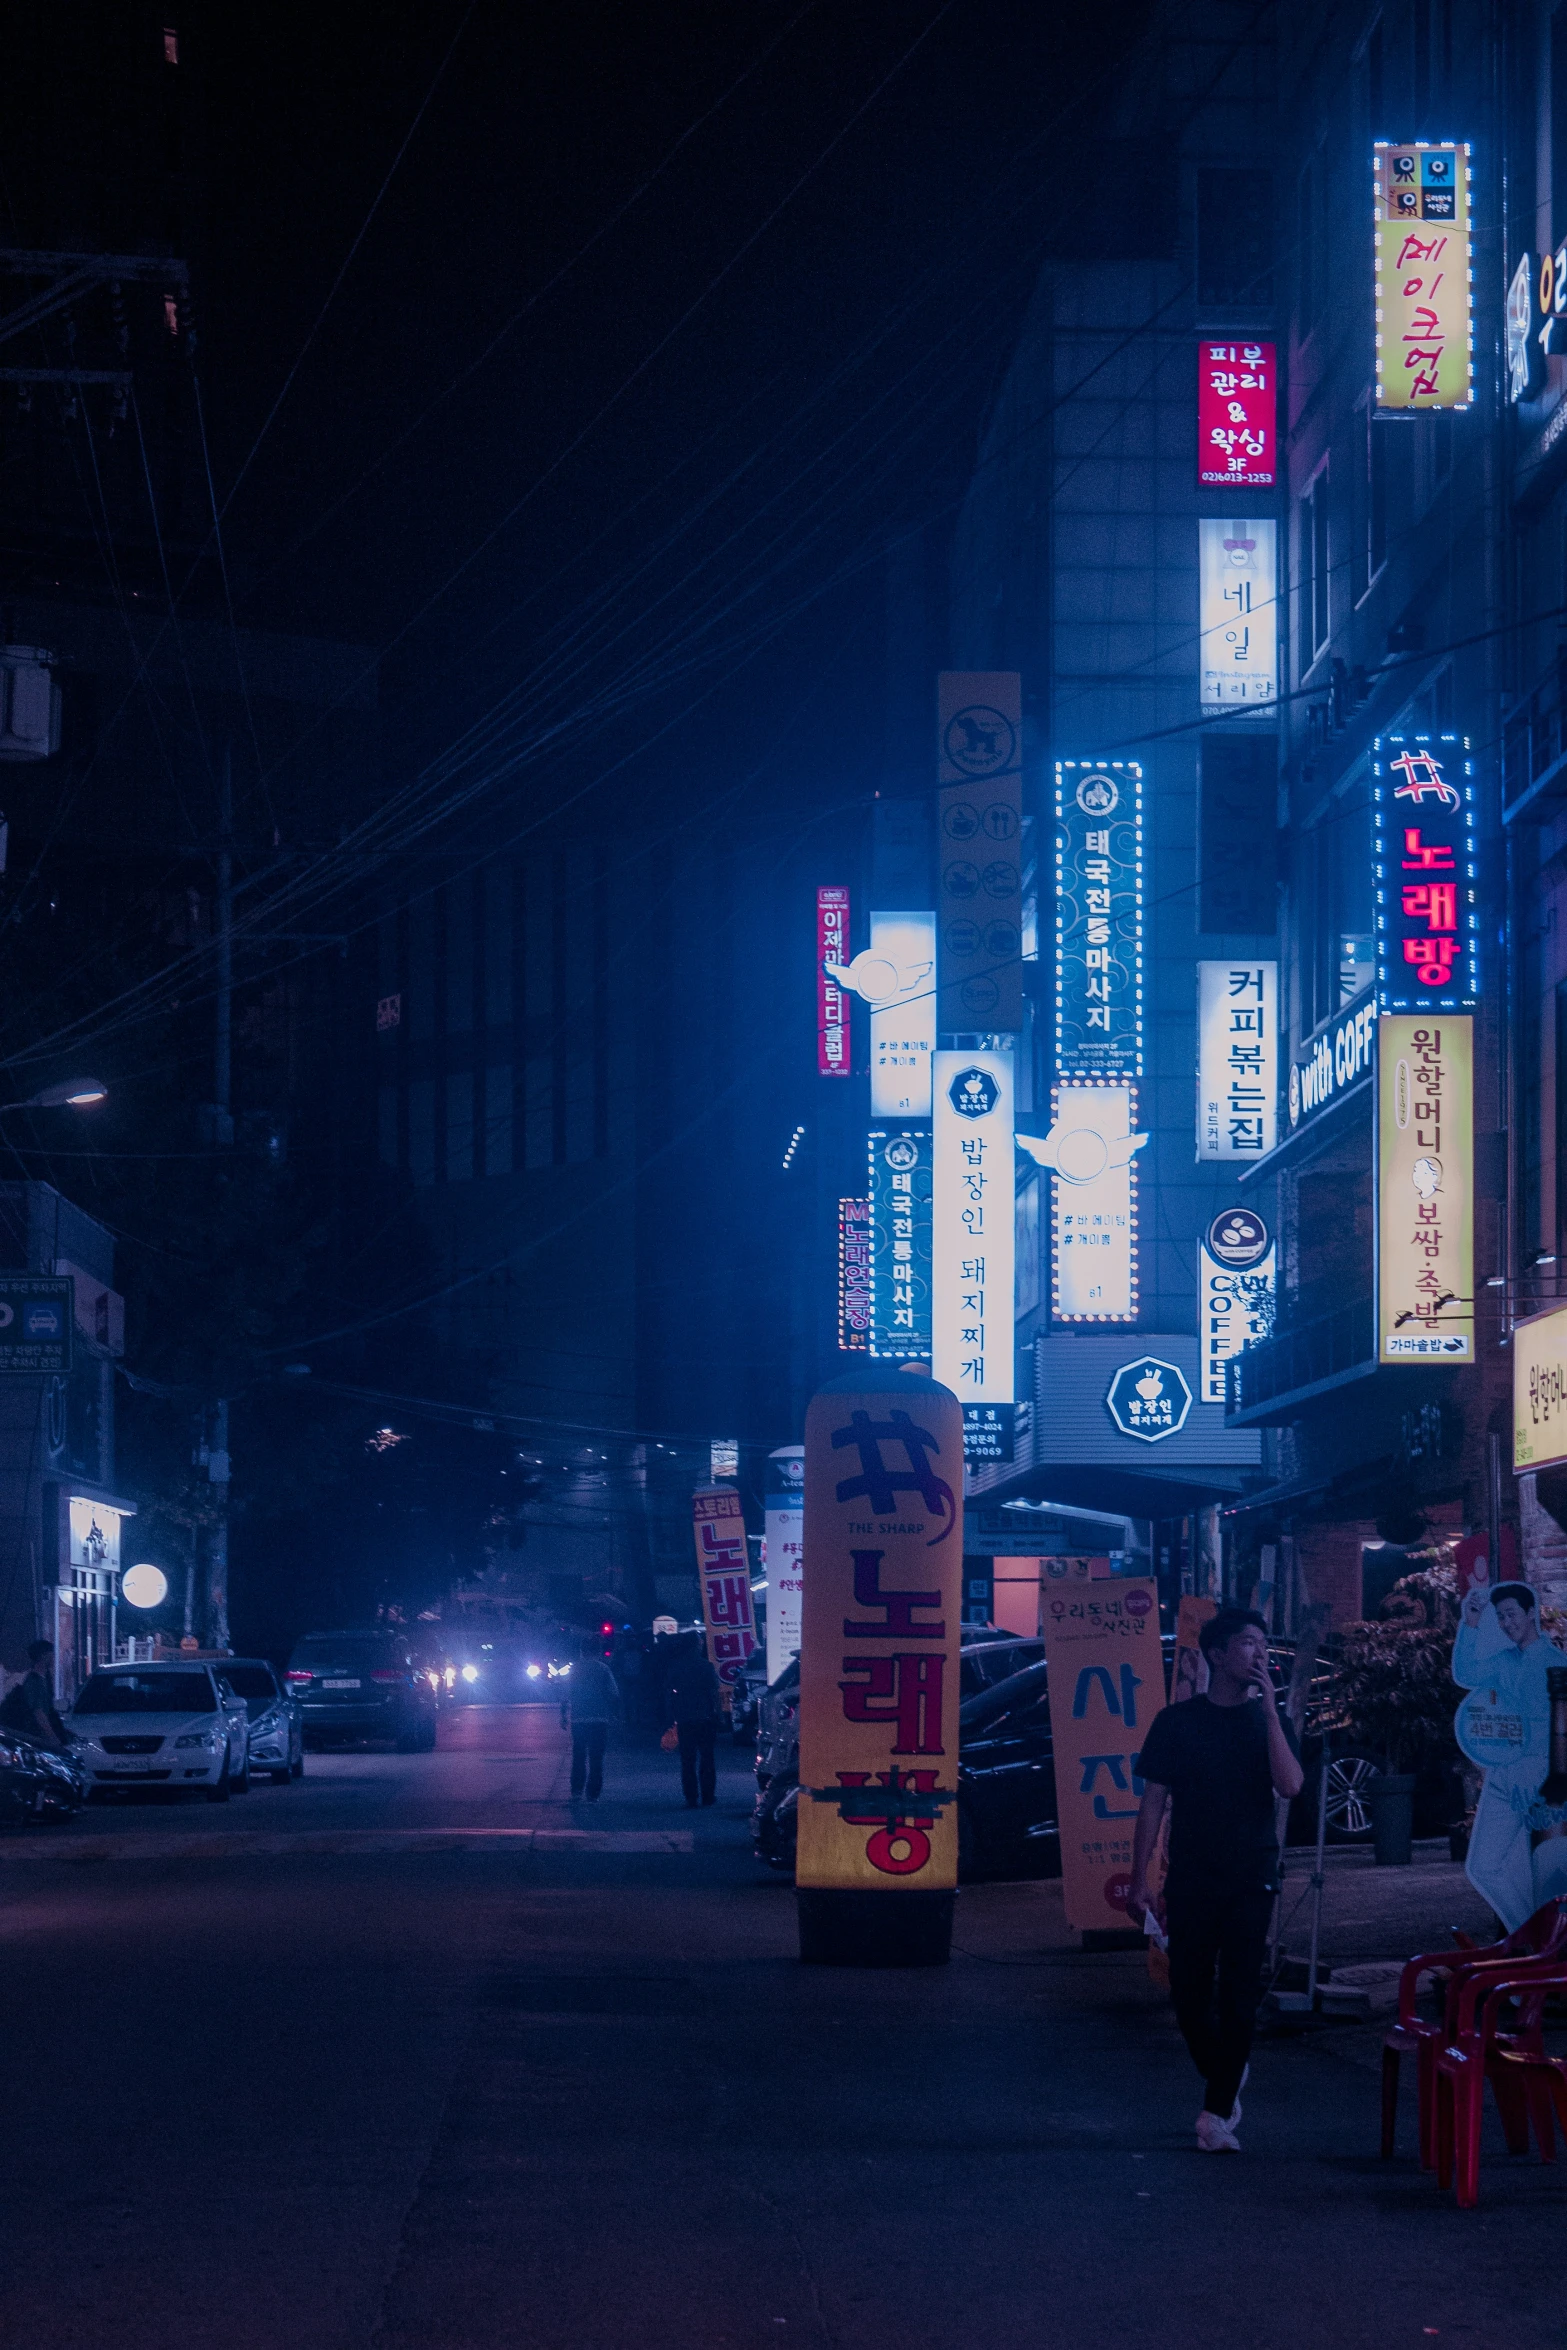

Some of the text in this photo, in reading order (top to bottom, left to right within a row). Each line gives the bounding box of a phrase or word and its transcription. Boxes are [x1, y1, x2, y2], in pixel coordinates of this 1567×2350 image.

[1396, 233, 1448, 399] 메이크업
[1209, 345, 1266, 371] 피부
[1210, 371, 1265, 397] 관리
[1227, 401, 1248, 423] &
[1210, 428, 1265, 456] 왁싱
[1201, 471, 1273, 483] 02)6013-1253
[1227, 457, 1247, 471] 3F
[1224, 581, 1251, 660] 네일
[1401, 828, 1461, 986] 노래방
[1227, 968, 1266, 1150] 커피볶는집
[1301, 1034, 1333, 1113] with
[1411, 1028, 1445, 1153] 원할머니
[1206, 1101, 1219, 1152] 위드커피
[959, 1136, 988, 1386] 밥장인 돼지찌개
[850, 1333, 866, 1344] B1
[1389, 1337, 1443, 1353] 가마솥밥
[1127, 1398, 1172, 1414] 밥장인
[848, 1522, 925, 1535] THE SHARP
[701, 1522, 756, 1685] 노래방
[1050, 1600, 1123, 1627] 우리동네
[1103, 1619, 1147, 1636] 사진관
